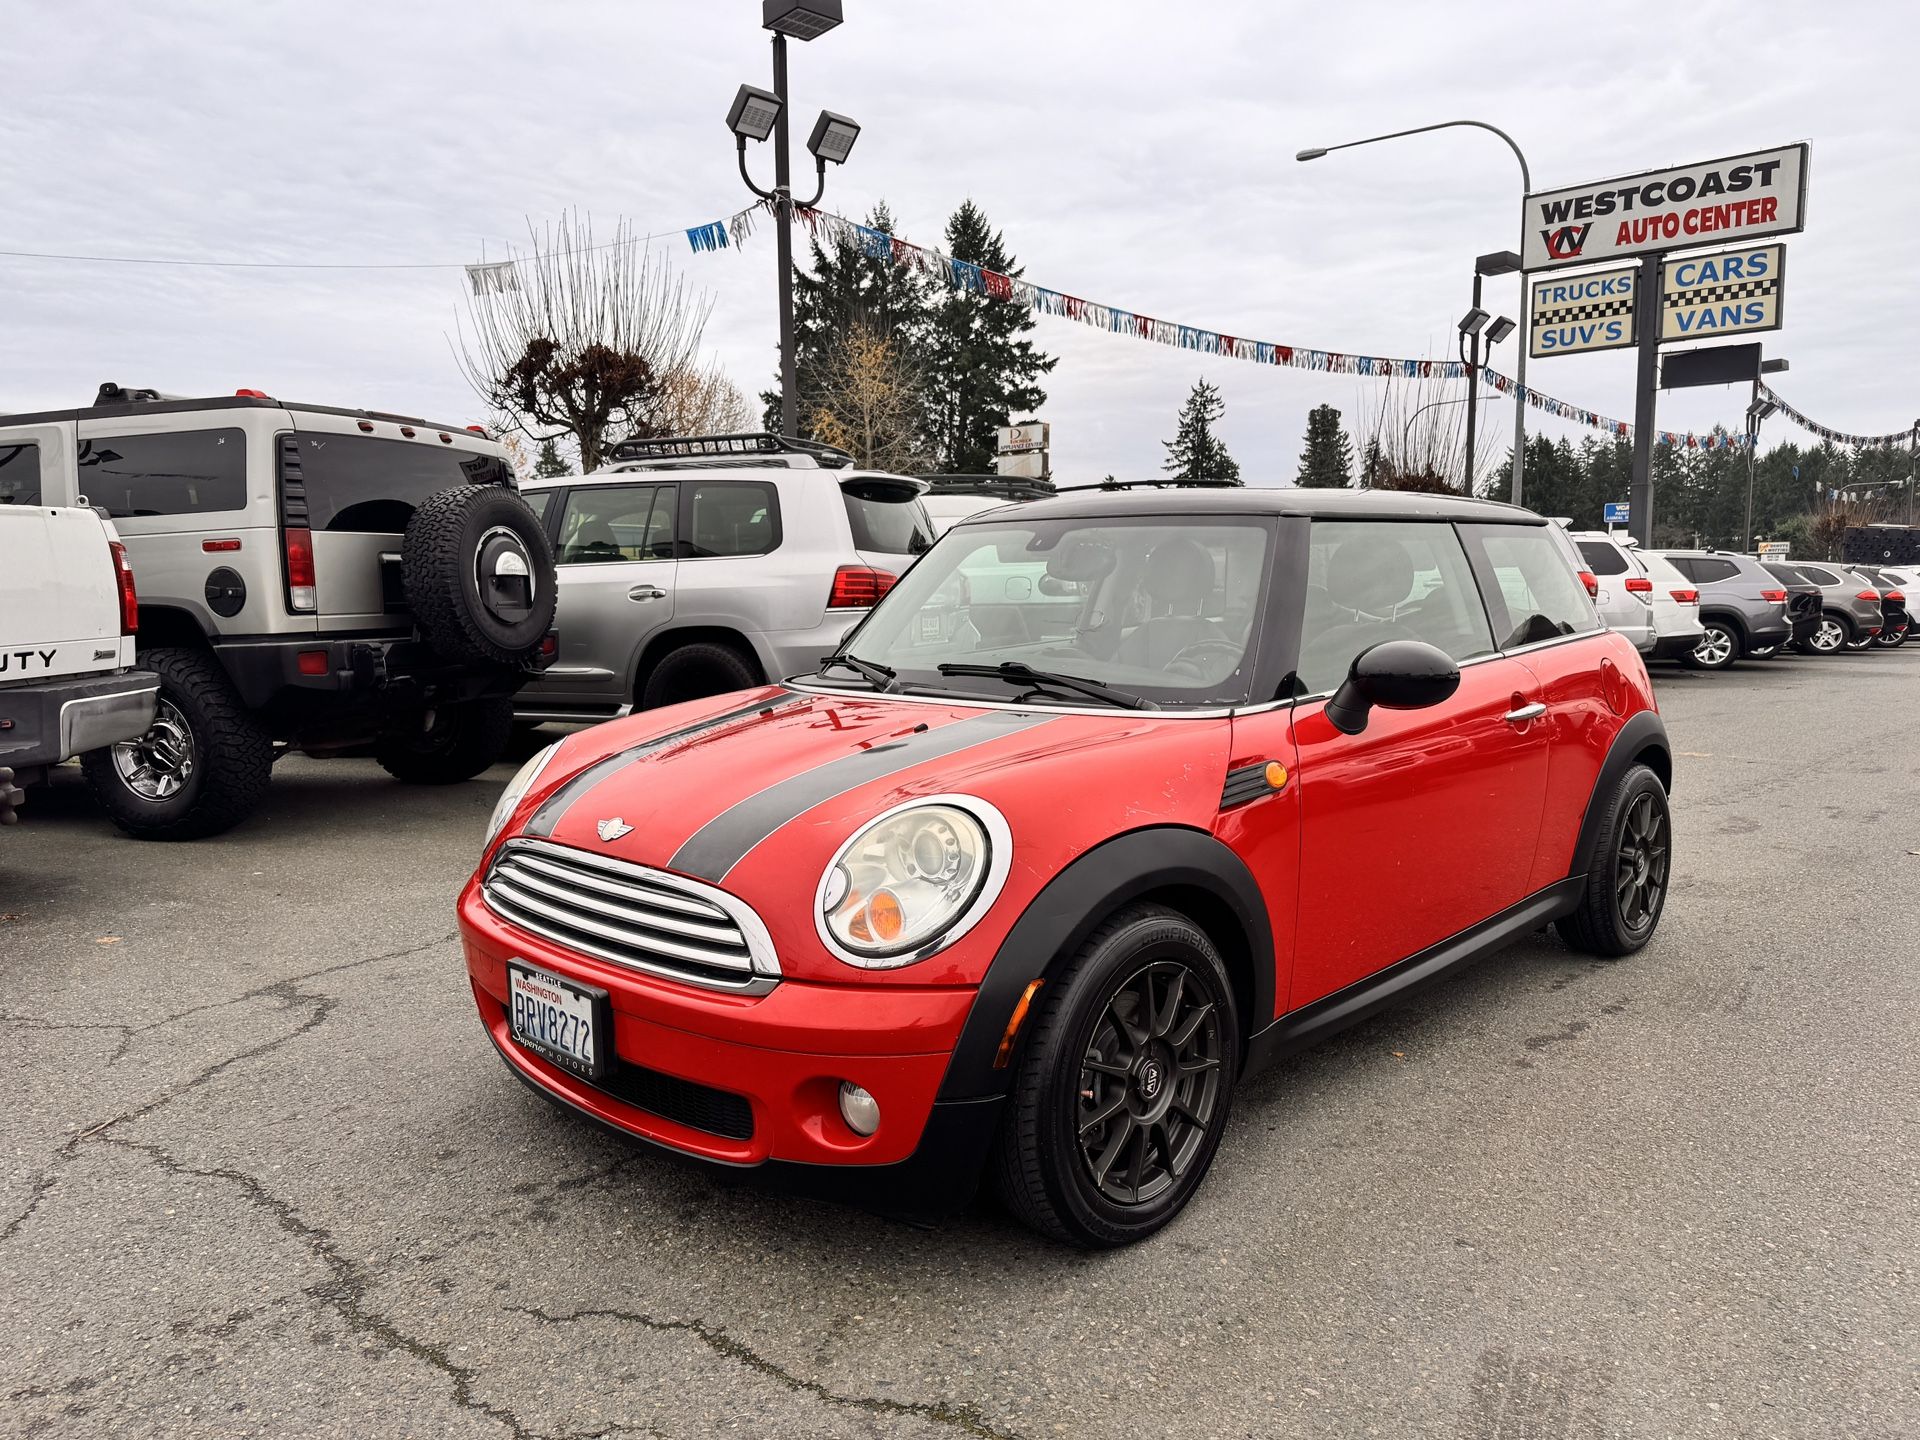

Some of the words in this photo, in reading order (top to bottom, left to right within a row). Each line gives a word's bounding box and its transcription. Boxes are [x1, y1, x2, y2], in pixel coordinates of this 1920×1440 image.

[1540, 159, 1780, 226] WESTCOAST
[1615, 212, 1680, 246] AUTO
[1683, 196, 1778, 235] CENTER
[1675, 252, 1768, 287] CARS
[1537, 275, 1632, 306] TRUCKS
[1675, 301, 1765, 333] VANS
[1540, 320, 1623, 350] SUV'S
[515, 978, 562, 1005] WASHINGTON
[535, 973, 562, 988] SEATTLE
[512, 1024, 546, 1054] Superior
[515, 991, 591, 1061] BRV8272
